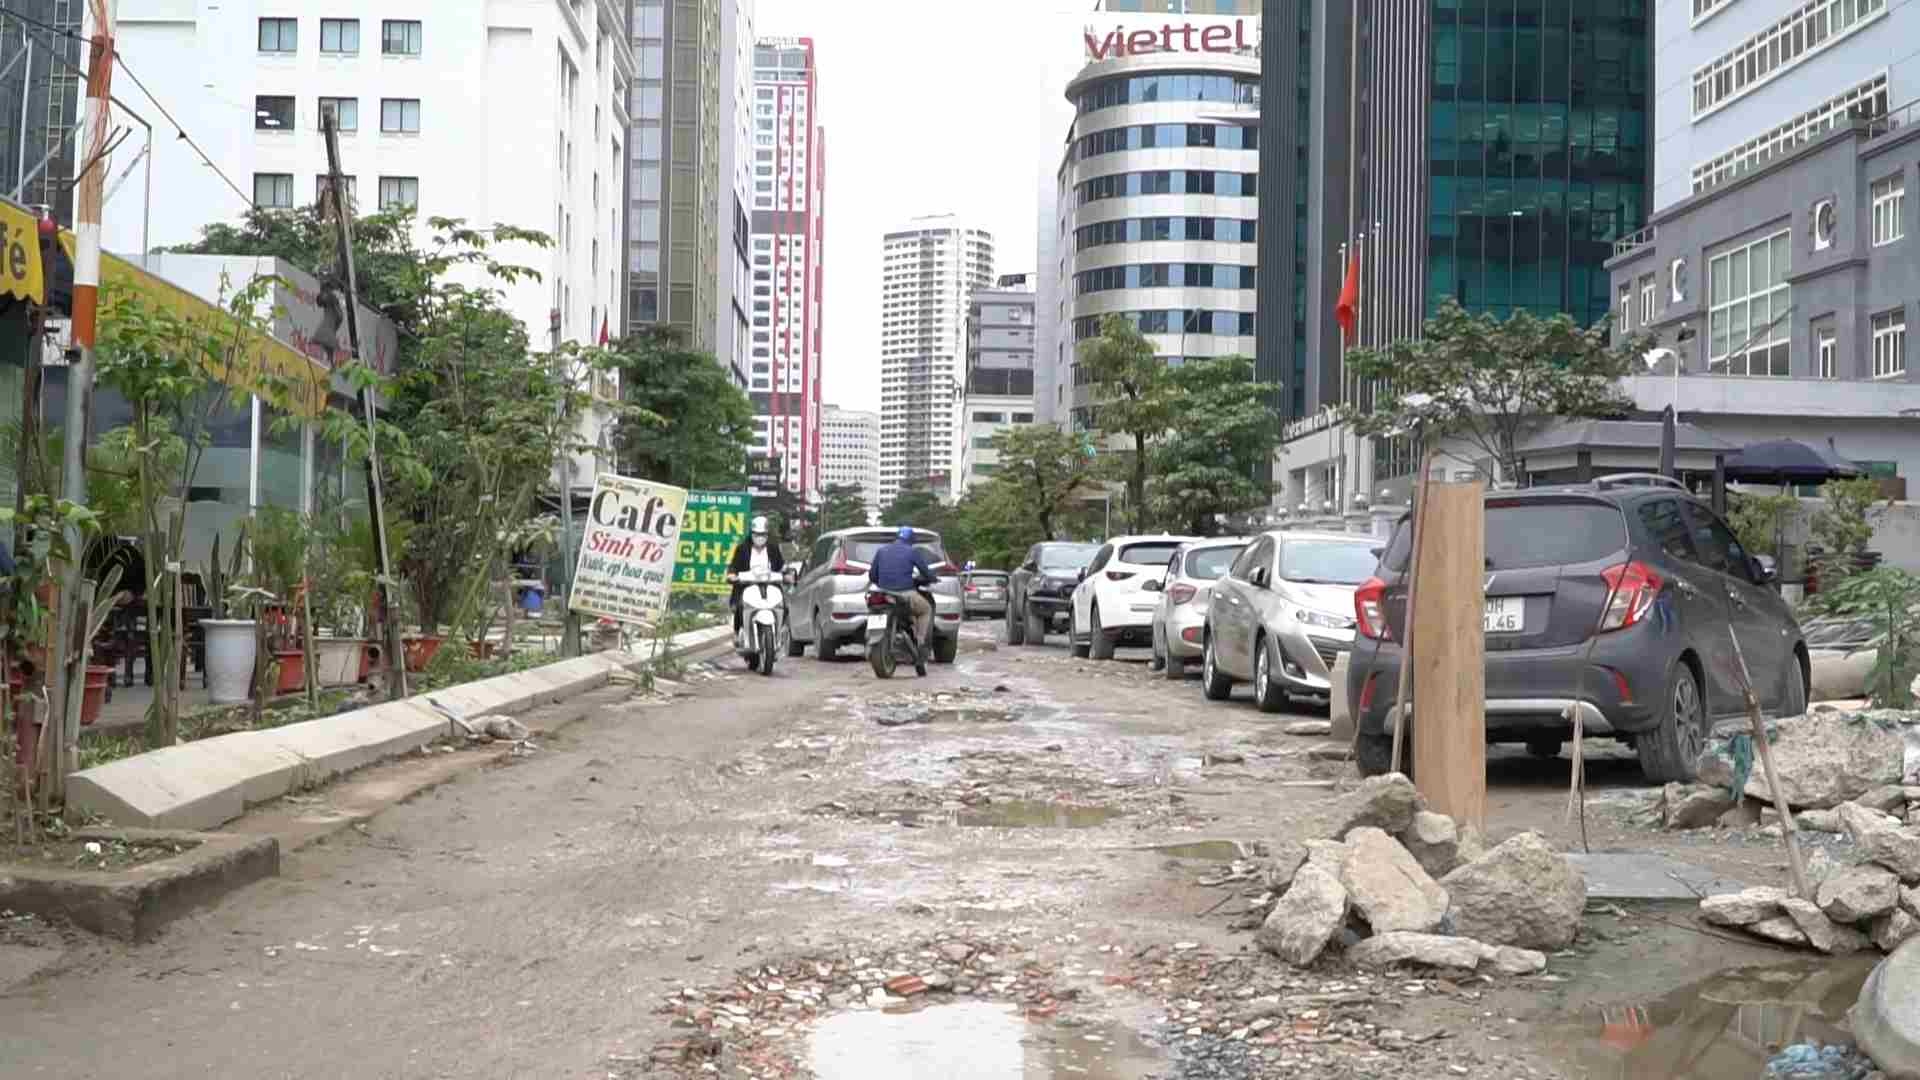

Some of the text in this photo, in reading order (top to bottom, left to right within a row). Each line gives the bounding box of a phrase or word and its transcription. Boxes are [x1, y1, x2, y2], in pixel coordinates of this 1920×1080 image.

[1084, 18, 1245, 60] viettel
[592, 490, 676, 538] Cafe
[680, 506, 745, 535] BÚN
[587, 531, 669, 563] Sinh Tố
[682, 567, 696, 582] 3
